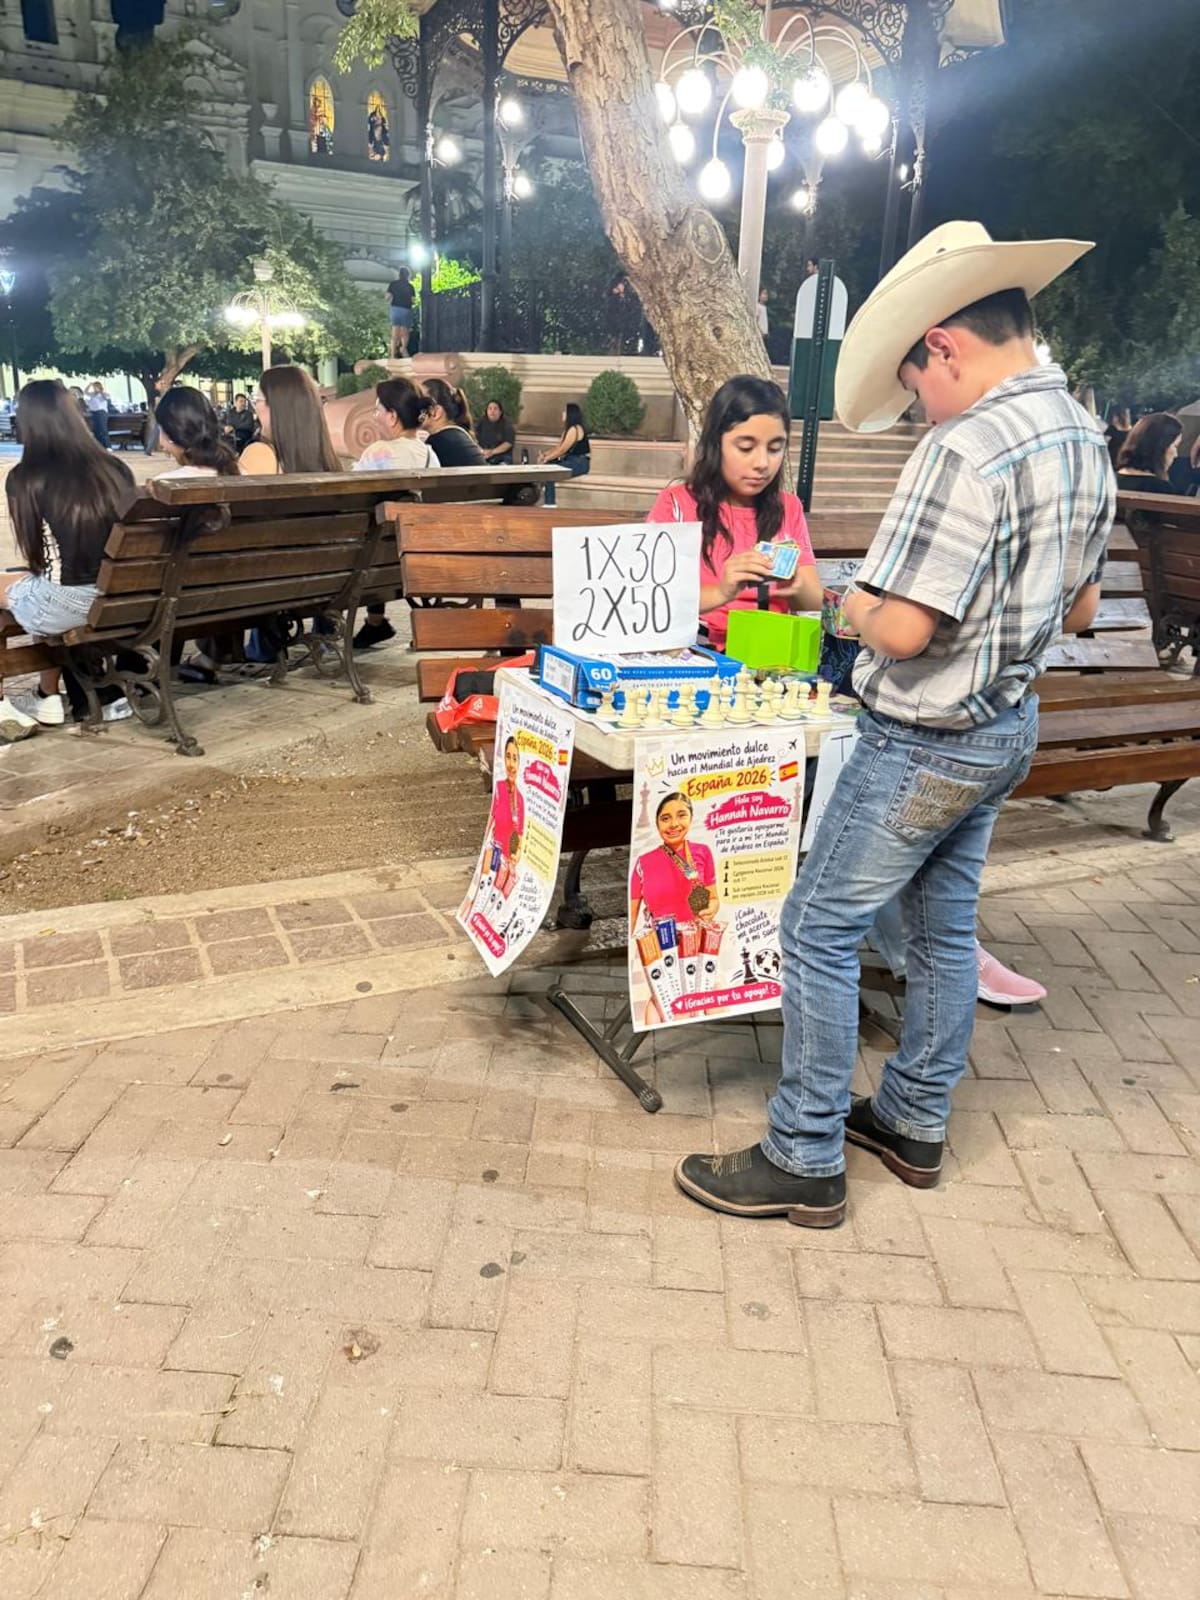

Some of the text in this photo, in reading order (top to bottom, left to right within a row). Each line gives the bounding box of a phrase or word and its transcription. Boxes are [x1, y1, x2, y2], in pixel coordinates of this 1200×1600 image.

[580, 531, 676, 585] 1X30
[572, 584, 671, 641] 2X50
[590, 668, 612, 680] 60
[670, 740, 769, 766] Un movimiento dulce
[667, 754, 776, 778] hacia el Mundial de Ajedrez
[687, 769, 768, 798] España 2026
[710, 804, 790, 826] Hannah Navarro
[716, 837, 730, 847] para
[766, 828, 789, 838] Mundial
[730, 842, 754, 854] Ajedrez
[736, 910, 768, 931] chocolate
[749, 920, 770, 934] acerca
[752, 932, 760, 942] mi
[684, 985, 769, 1010] ¡Gracias por tu apoyo!
